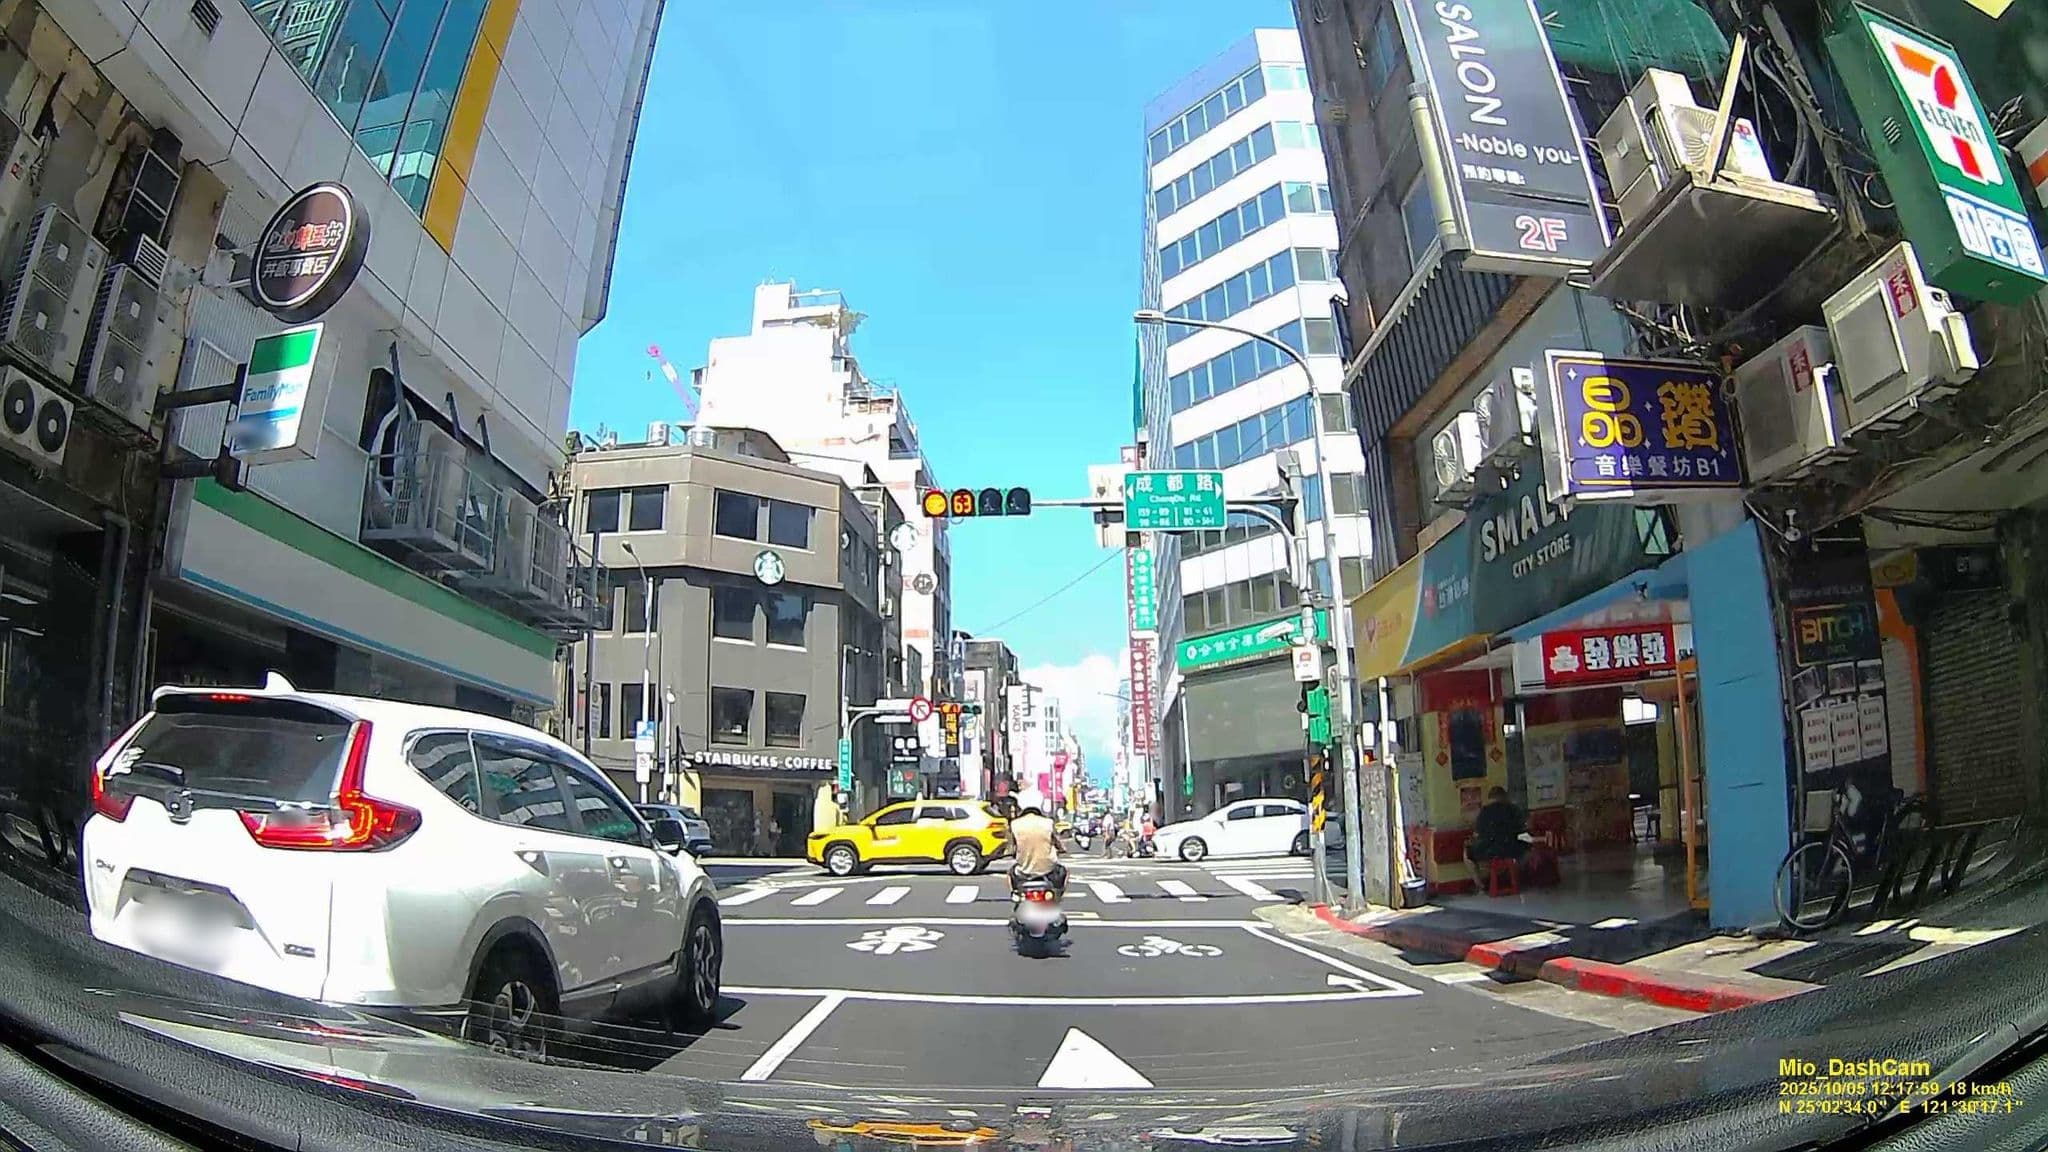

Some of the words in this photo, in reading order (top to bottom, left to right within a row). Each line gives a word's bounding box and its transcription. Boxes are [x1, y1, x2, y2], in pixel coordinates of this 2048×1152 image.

[1435, 1, 1508, 126] SALON
[1515, 215, 1568, 252] 2F
[1594, 453, 1691, 477] 音樂餐坊
[1696, 457, 1720, 478] B1
[1136, 474, 1214, 492] 成都路
[953, 494, 973, 514] 63
[1512, 556, 1534, 578] CITY
[1536, 533, 1572, 566] STORE
[1583, 632, 1667, 671] 發樂發
[694, 750, 778, 769] STARBUCKS
[784, 756, 833, 771] COFFEE
